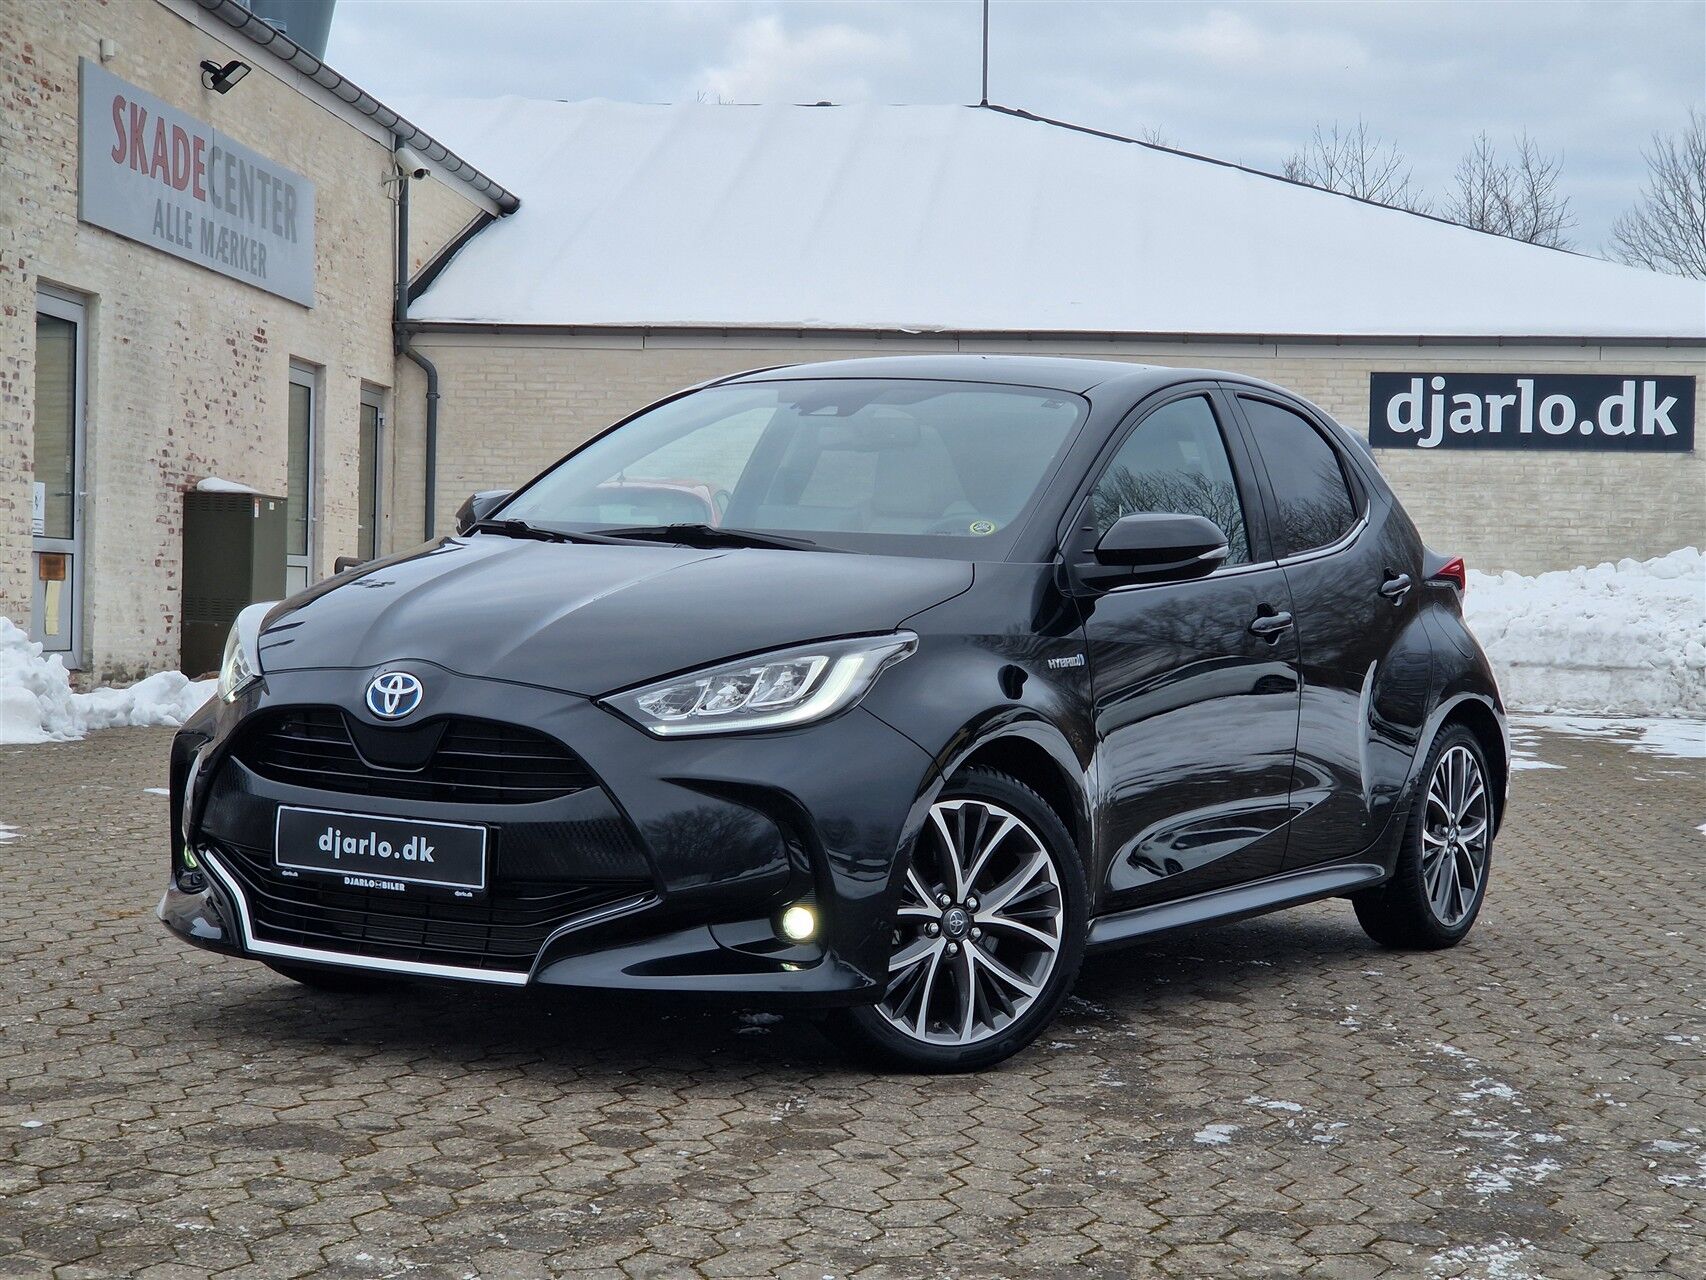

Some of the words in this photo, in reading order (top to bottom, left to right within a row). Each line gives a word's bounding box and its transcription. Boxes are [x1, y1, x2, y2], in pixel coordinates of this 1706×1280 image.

[152, 198, 193, 250] ALLE
[200, 216, 267, 280] MÆRKER
[1386, 375, 1678, 448] djarlo.dk
[318, 826, 435, 863] djarlo.dk
[344, 876, 375, 888] DJARLO
[382, 881, 406, 892] BILER
